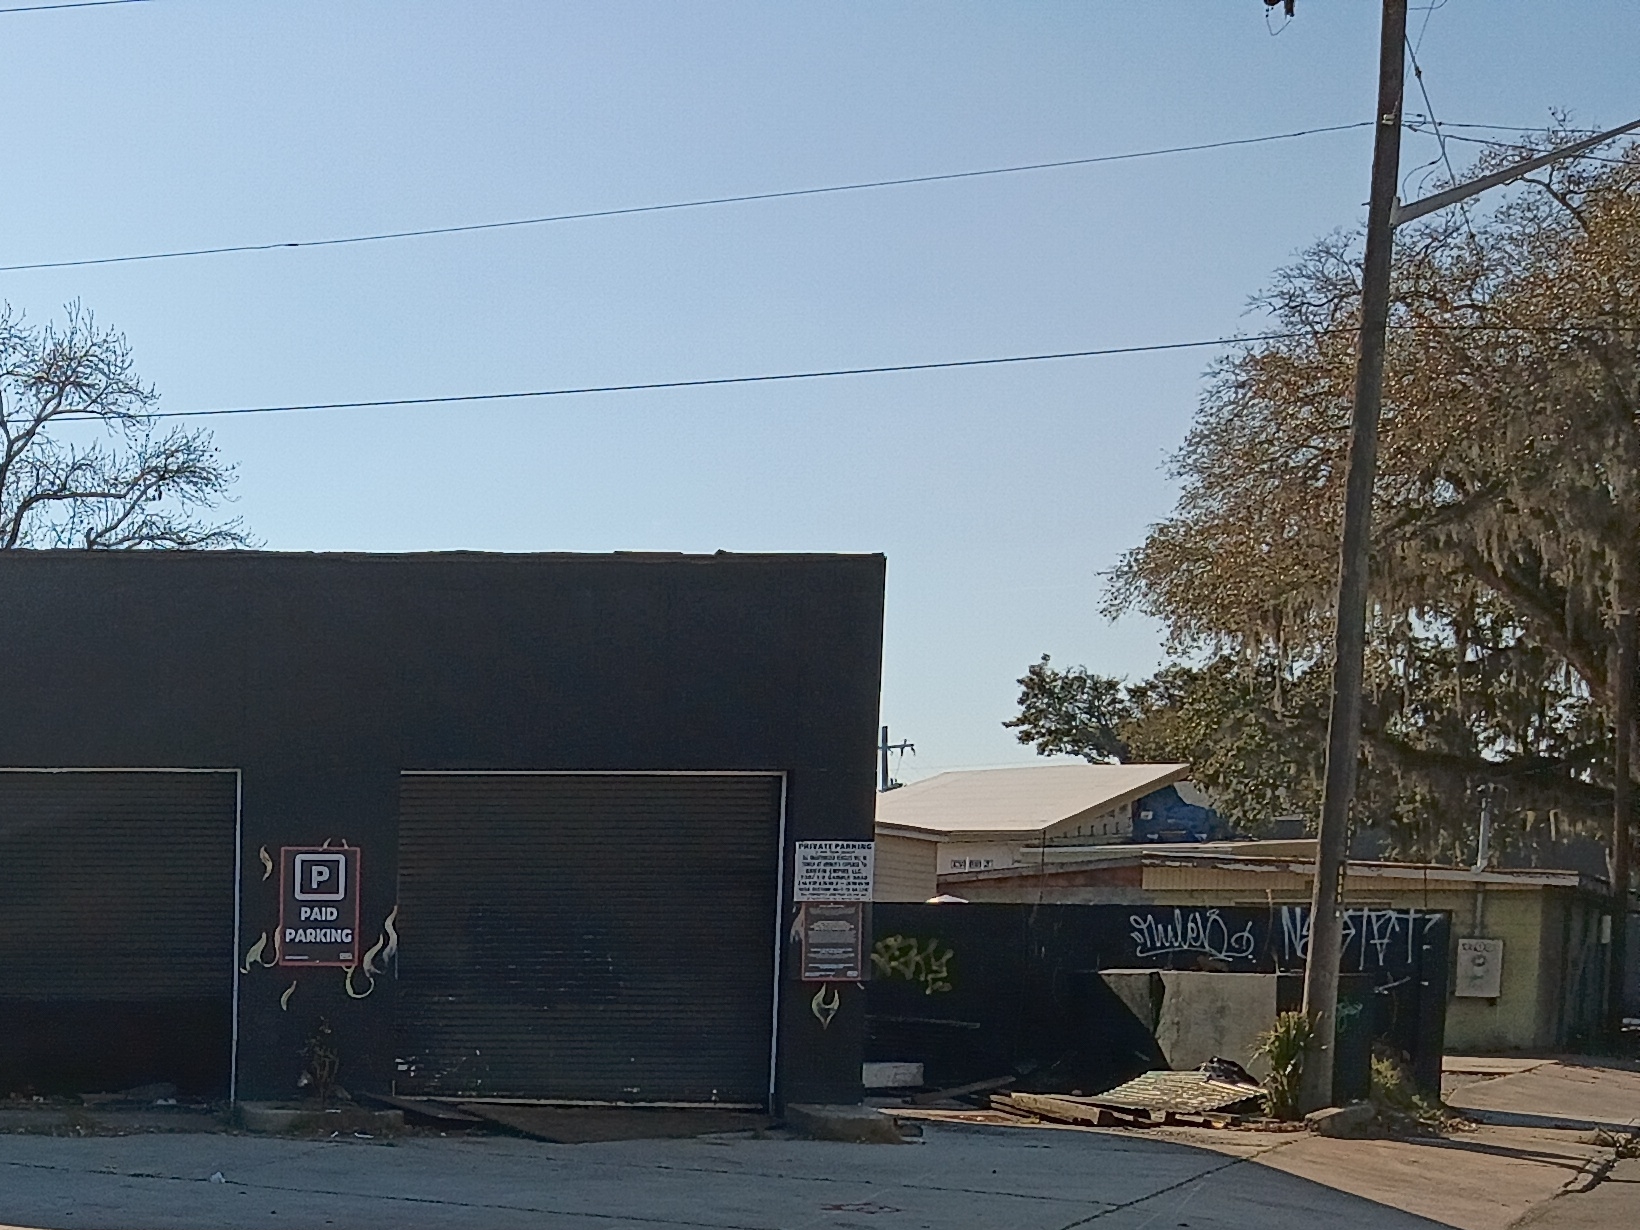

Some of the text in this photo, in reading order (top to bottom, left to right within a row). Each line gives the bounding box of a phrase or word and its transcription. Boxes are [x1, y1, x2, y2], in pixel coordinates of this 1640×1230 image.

[311, 865, 330, 889] P
[300, 906, 338, 921] PAID
[285, 928, 352, 943] PARKING
